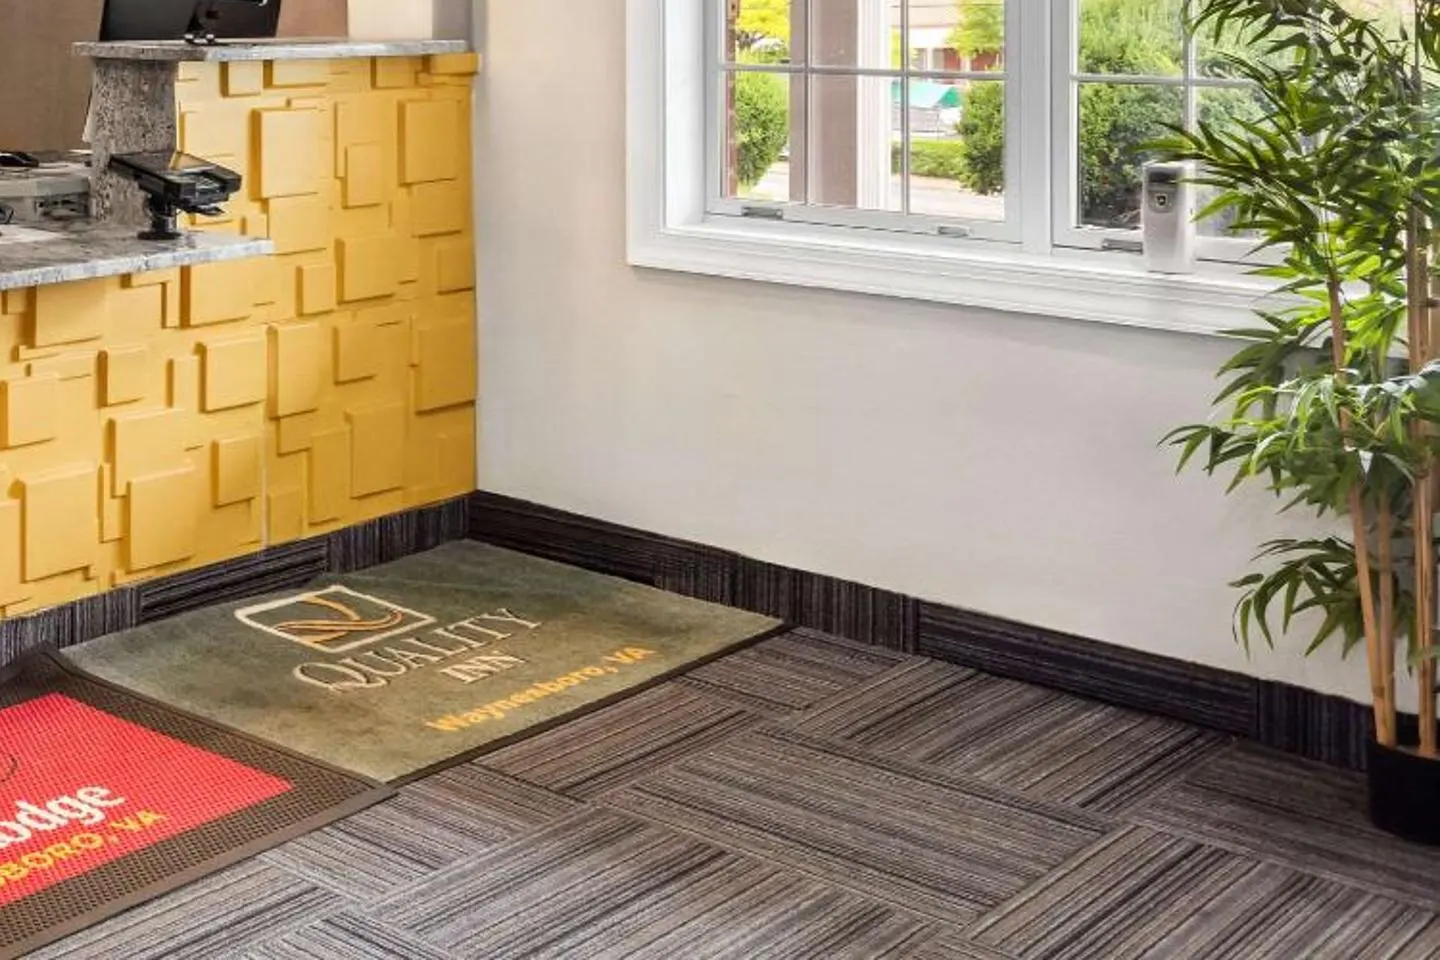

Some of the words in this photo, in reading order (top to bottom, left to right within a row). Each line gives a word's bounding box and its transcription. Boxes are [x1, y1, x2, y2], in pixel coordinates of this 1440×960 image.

[293, 608, 541, 691] QUALITY
[602, 646, 657, 664] VA
[440, 650, 527, 684] INN
[112, 810, 165, 831] VA
